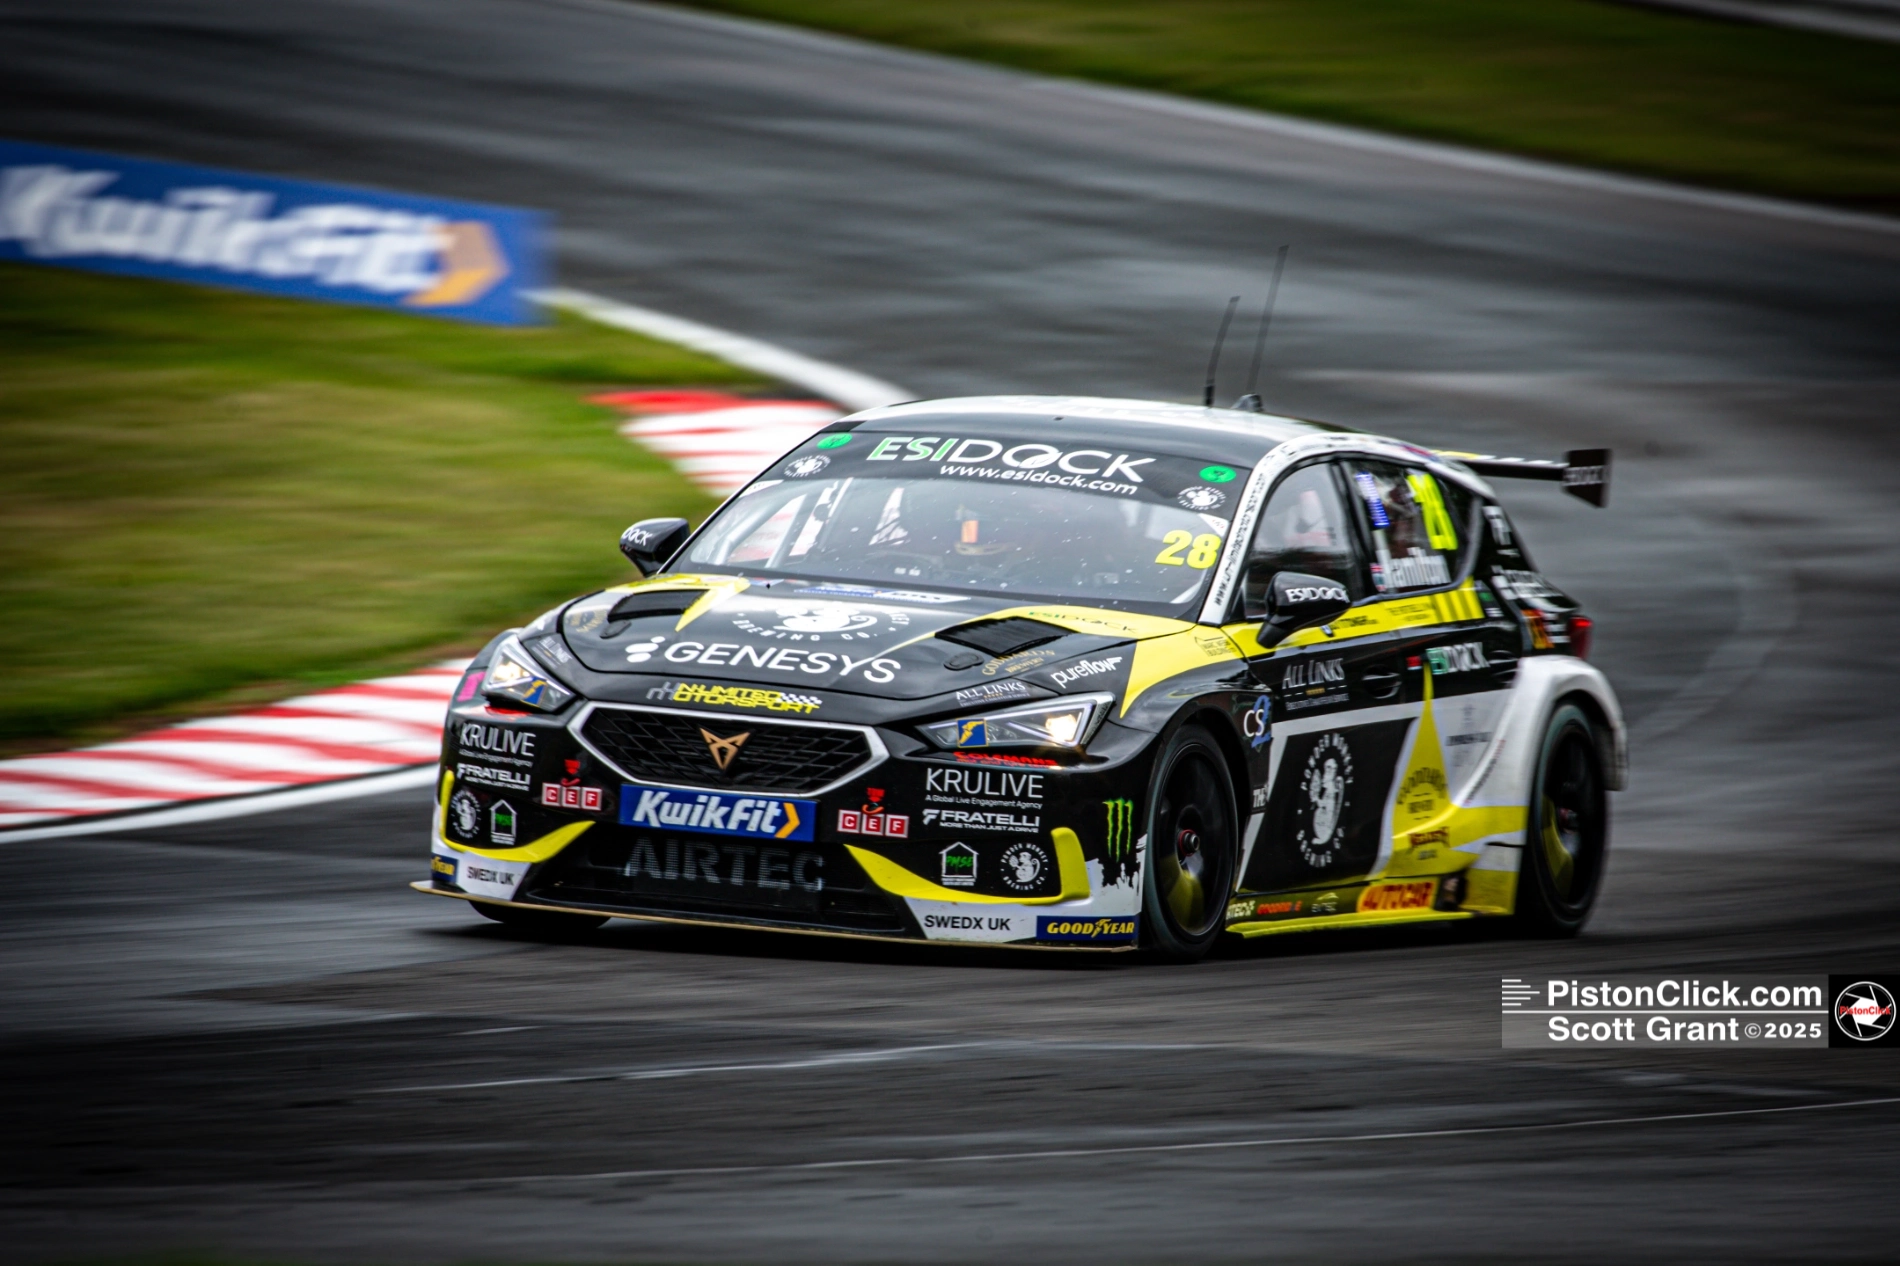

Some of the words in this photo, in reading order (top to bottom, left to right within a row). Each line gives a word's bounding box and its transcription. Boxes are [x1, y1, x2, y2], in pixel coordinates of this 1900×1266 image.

[866, 437, 1156, 483] ESIDOCK
[940, 464, 1138, 495] www.esidock.com
[1155, 530, 1222, 569] 28
[664, 641, 901, 683] GENESYS
[1051, 656, 1122, 689] pureflow
[956, 688, 984, 701] ALL
[983, 680, 1027, 695] LINKS
[460, 722, 537, 757] KRULIVE
[465, 764, 531, 786] FRATELLI
[926, 767, 1044, 799] KRULIVE
[632, 790, 783, 834] KwikFit
[941, 810, 1040, 828] FRATELLI
[955, 796, 970, 804] Live
[971, 797, 1016, 808] Engagement
[1016, 801, 1043, 811] Agency
[624, 836, 826, 893] AIRTEC
[924, 915, 984, 930] SWEDX
[988, 918, 1011, 931] UK
[1046, 918, 1135, 938] GOODYEAR
